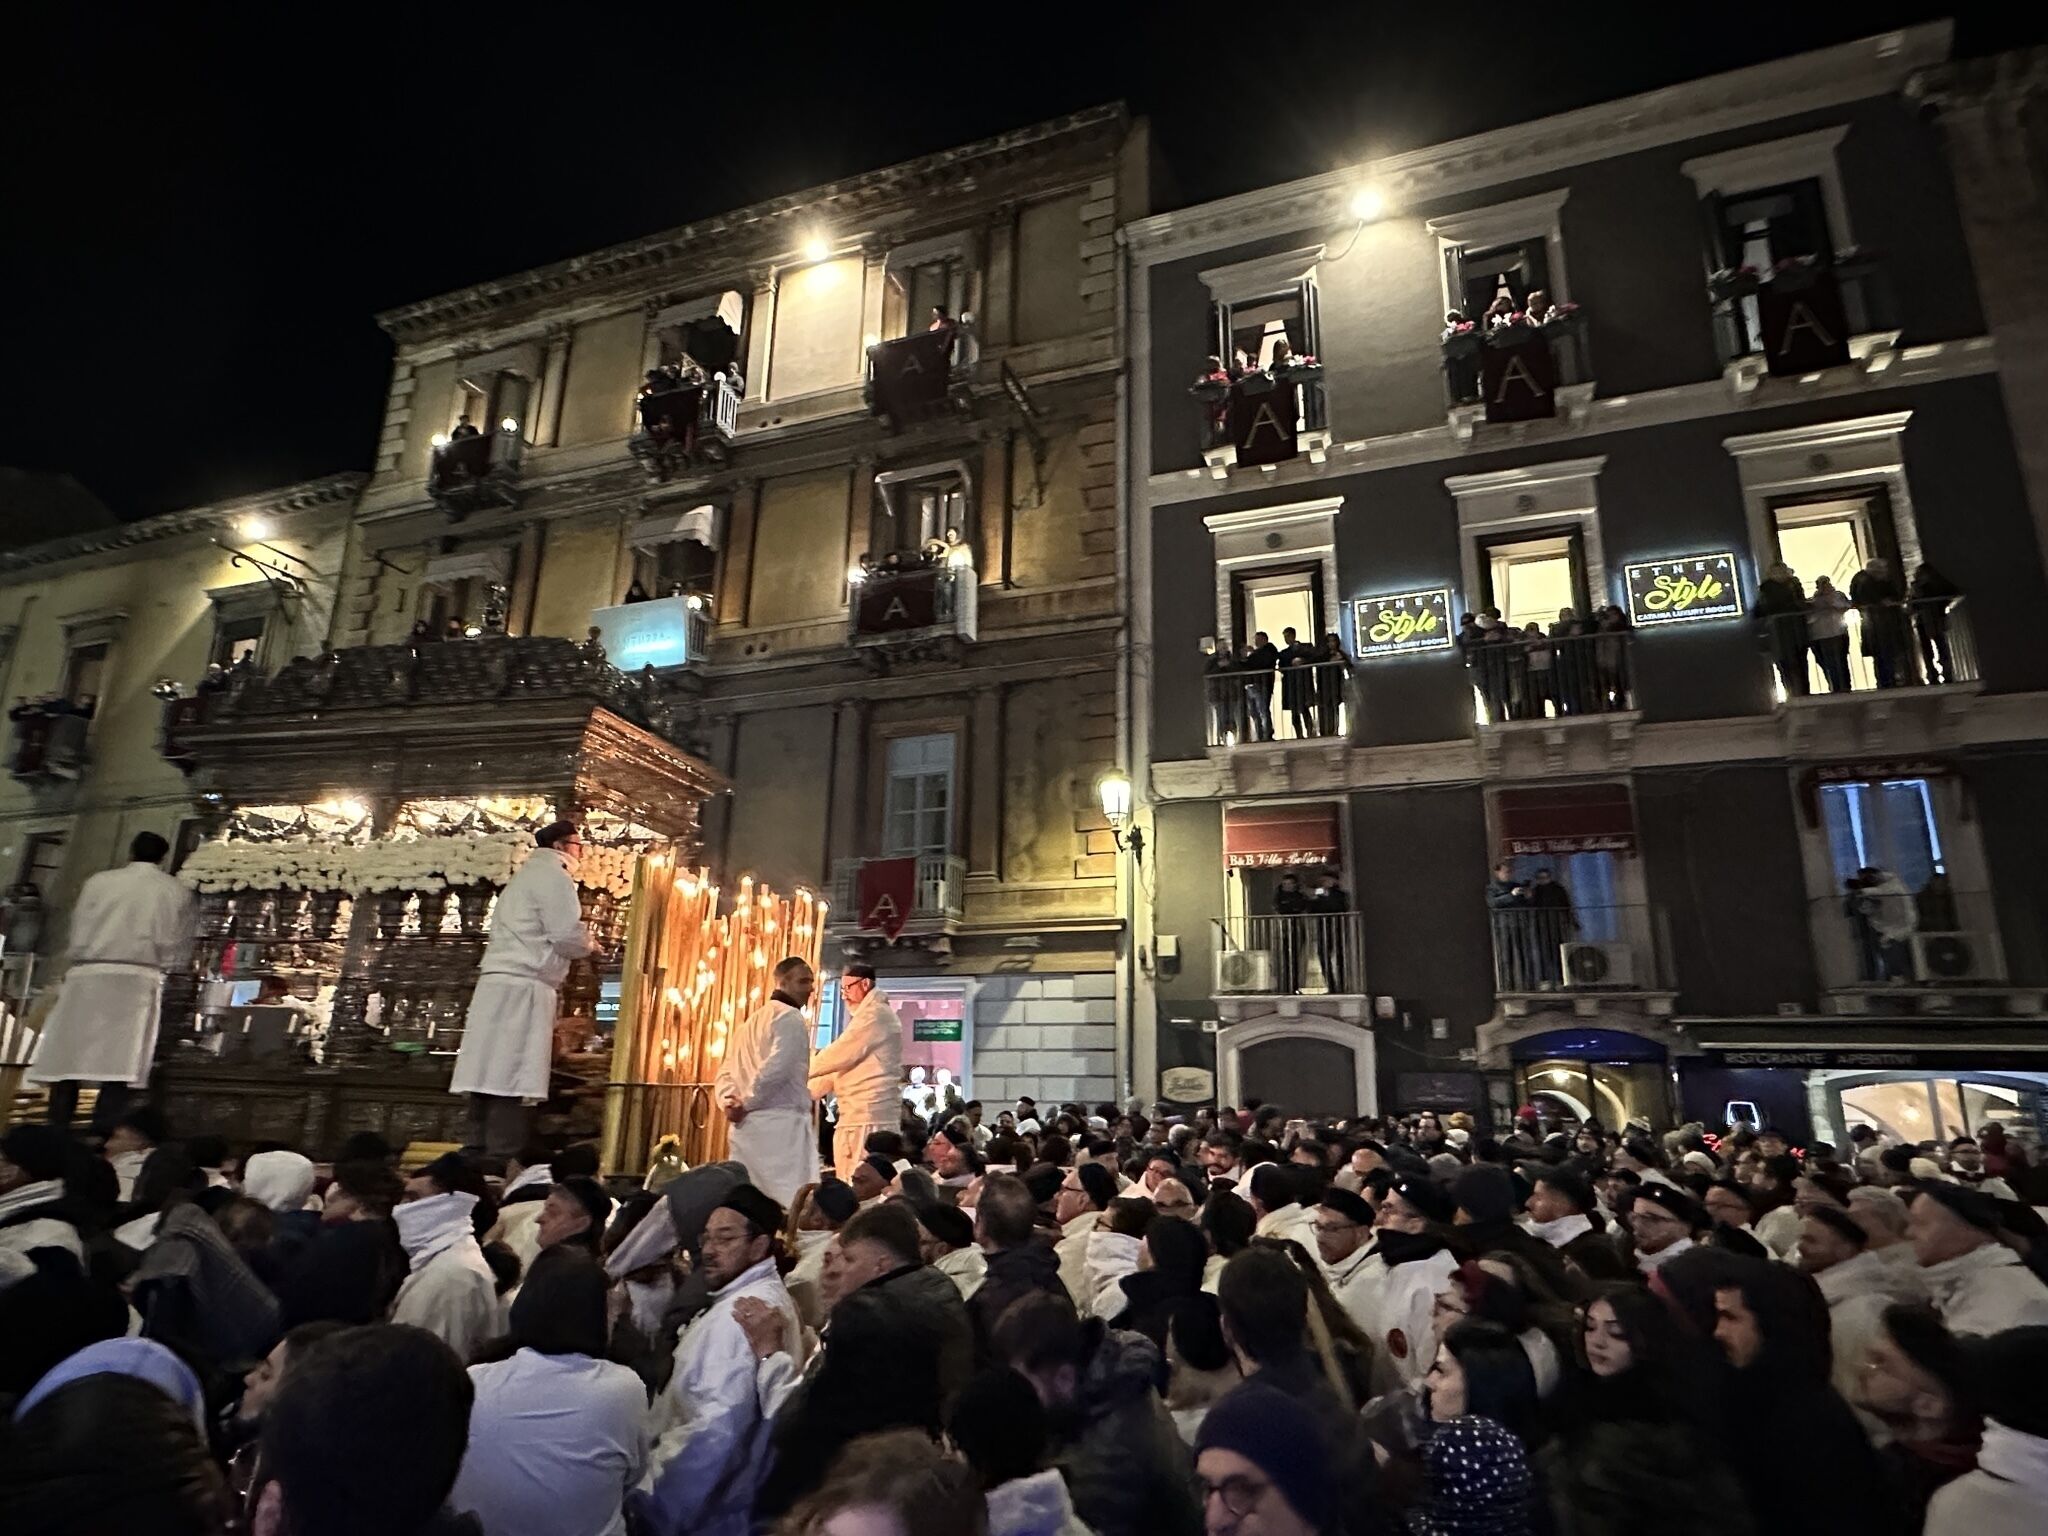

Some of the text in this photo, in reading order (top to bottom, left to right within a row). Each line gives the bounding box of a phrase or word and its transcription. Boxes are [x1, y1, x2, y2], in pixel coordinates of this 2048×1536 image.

[1777, 301, 1837, 357] A
[1494, 355, 1546, 404] A
[1242, 402, 1290, 450] A
[1631, 559, 1728, 578] ETNEA
[1360, 595, 1443, 613] ETNEA
[1644, 573, 1723, 610] Style
[882, 596, 910, 621] A
[1369, 608, 1437, 643] Style
[1229, 854, 1254, 866] B&B
[1257, 853, 1283, 865] Villa
[869, 893, 899, 918] A
